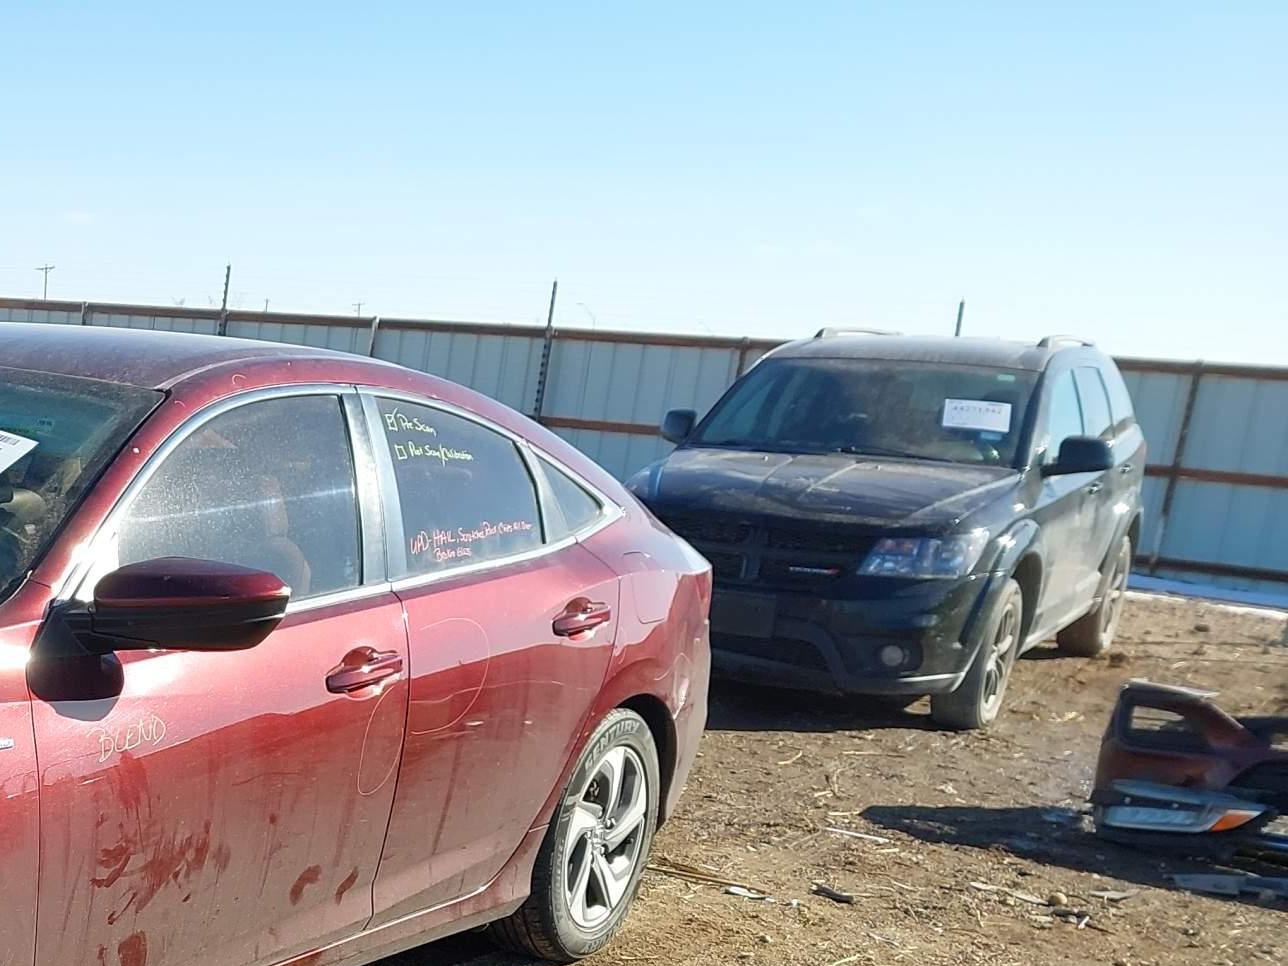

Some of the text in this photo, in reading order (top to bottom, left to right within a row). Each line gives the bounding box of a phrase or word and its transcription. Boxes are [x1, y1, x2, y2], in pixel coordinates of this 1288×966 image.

[397, 413, 437, 437] Pre Scan
[86, 714, 167, 763] BLEND
[585, 719, 641, 770] CENTURY
